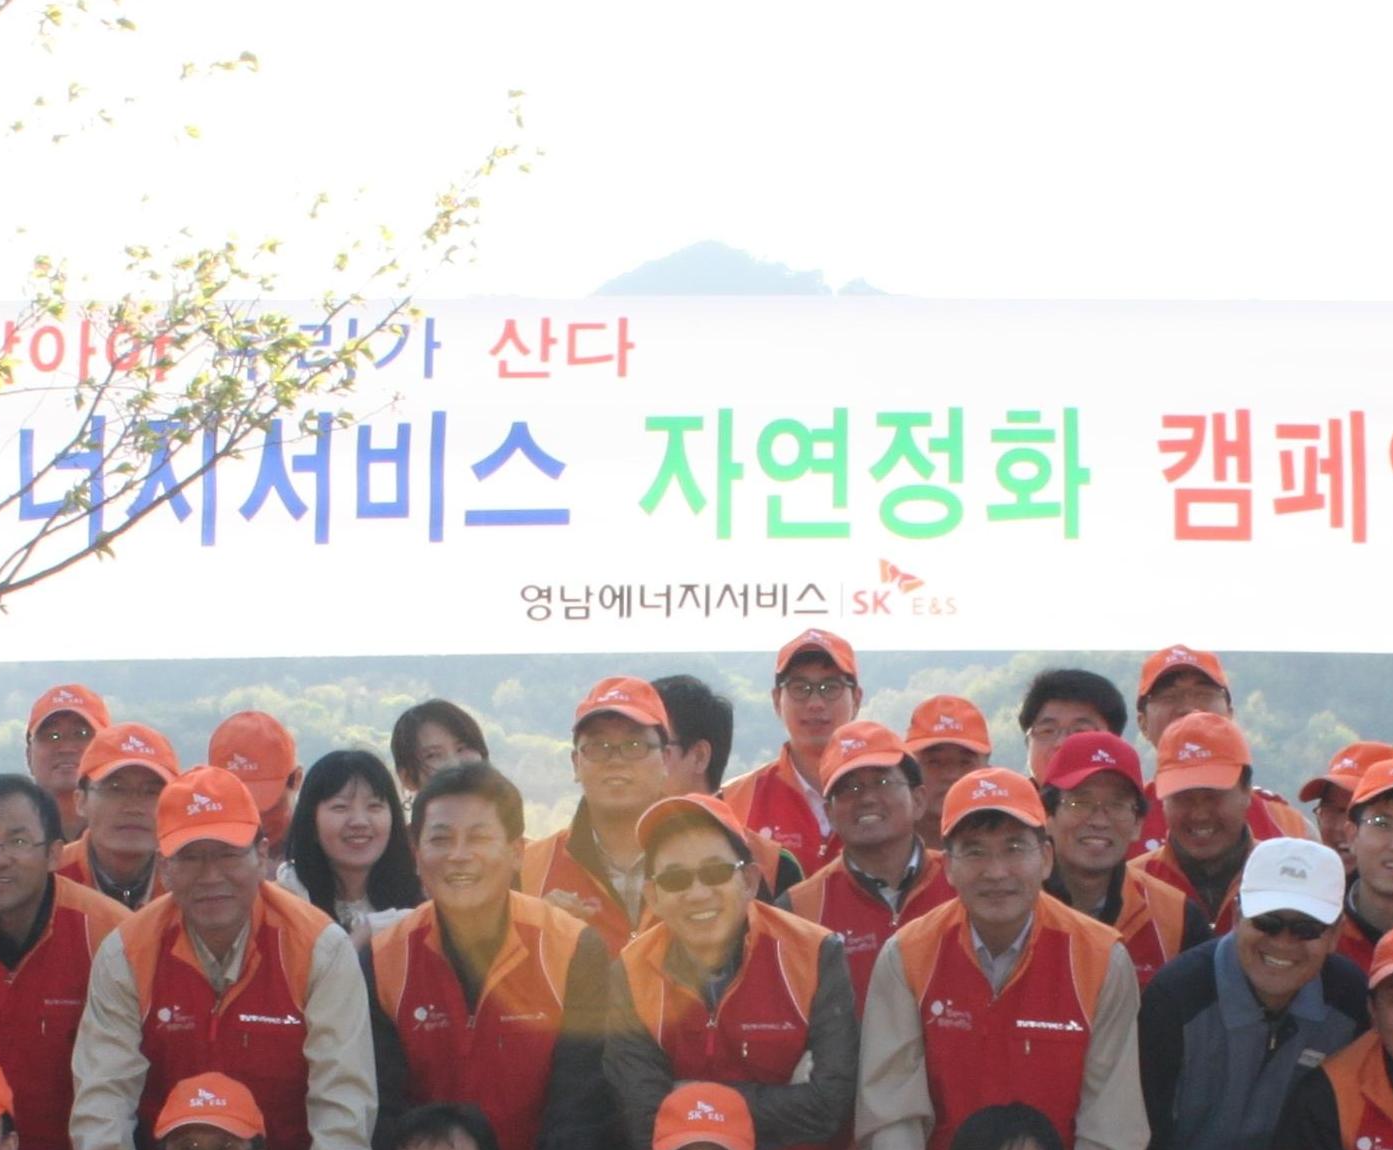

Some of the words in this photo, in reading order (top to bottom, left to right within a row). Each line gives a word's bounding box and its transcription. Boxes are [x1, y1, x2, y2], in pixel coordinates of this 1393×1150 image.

[489, 315, 636, 381] 산다
[638, 405, 1092, 542] 자연정화
[518, 580, 830, 622] 영남에너지서비스
[852, 589, 892, 616] SK
[911, 597, 958, 616] E&S
